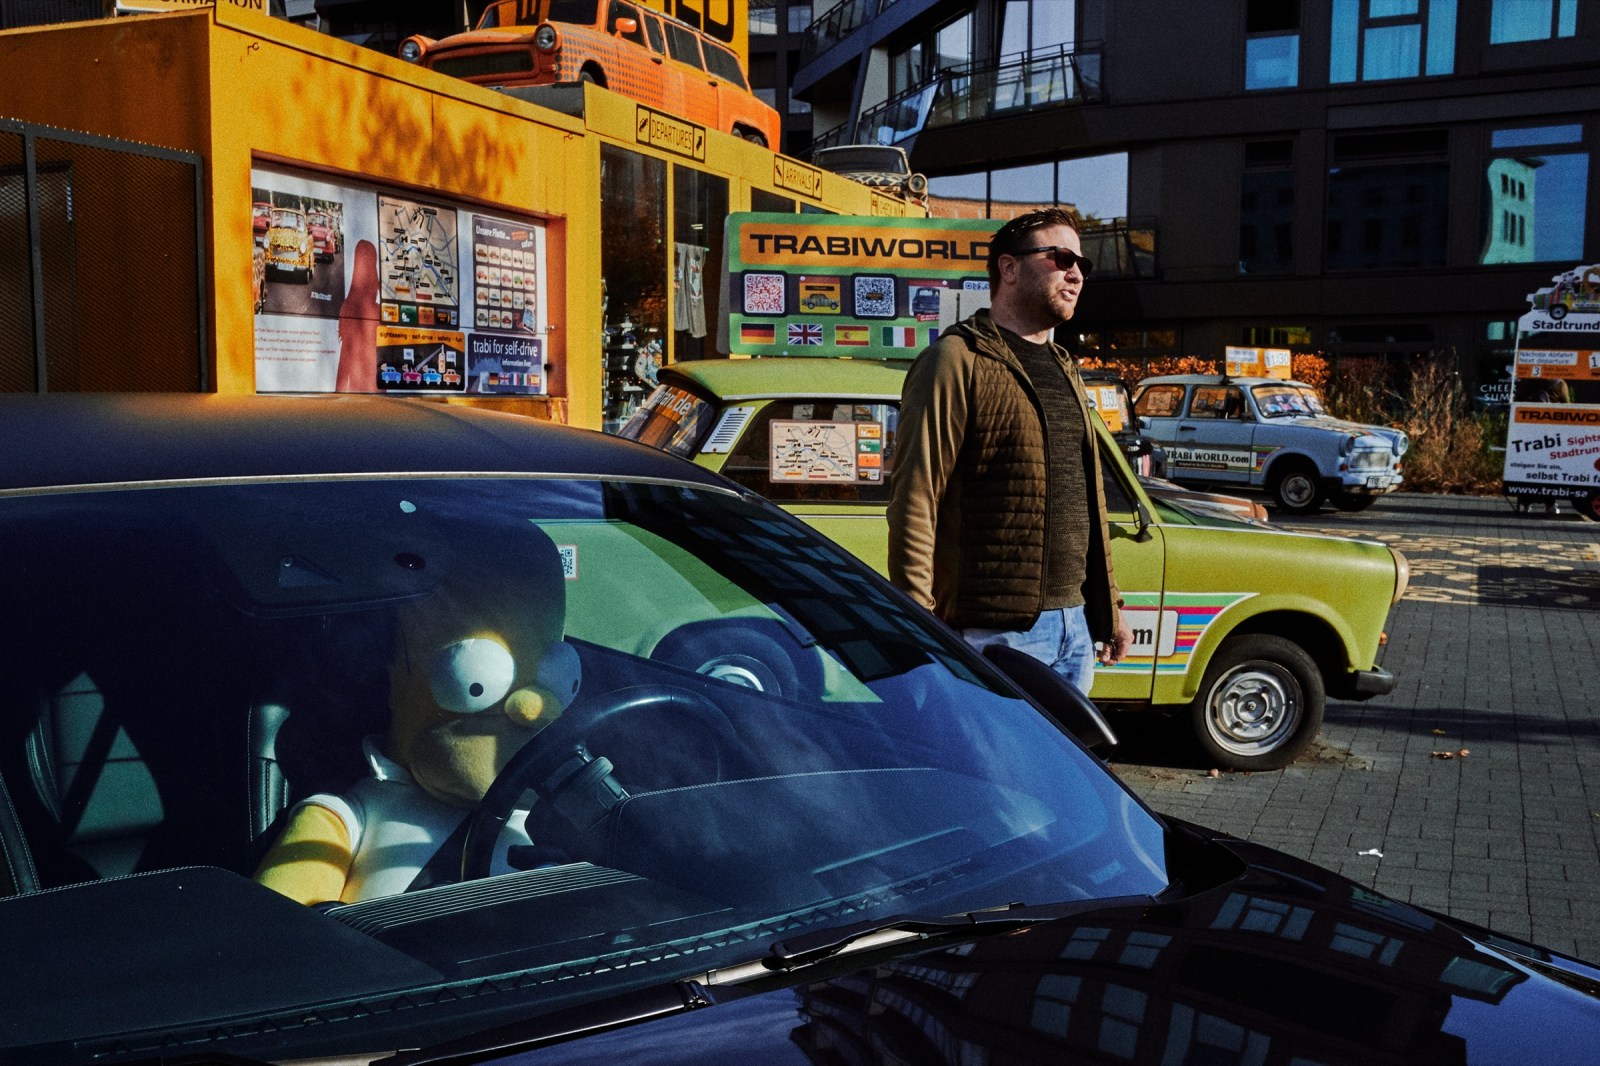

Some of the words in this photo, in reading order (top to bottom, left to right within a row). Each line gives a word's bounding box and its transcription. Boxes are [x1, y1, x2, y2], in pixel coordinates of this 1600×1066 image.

[651, 119, 692, 150] DEPARTURES
[784, 167, 812, 191] ARRIVALS
[749, 233, 989, 261] TRABIWORLD
[473, 338, 492, 354] trabi
[492, 339, 504, 355] for
[504, 340, 538, 357] self-drive
[1533, 367, 1539, 376] 3
[1519, 410, 1600, 422] TRABIWO
[1511, 433, 1562, 453] Trabi
[1167, 450, 1192, 460] TRABI
[1549, 446, 1600, 460] Stadtrun
[1525, 471, 1559, 480] selbst
[1561, 473, 1590, 482] Trabi
